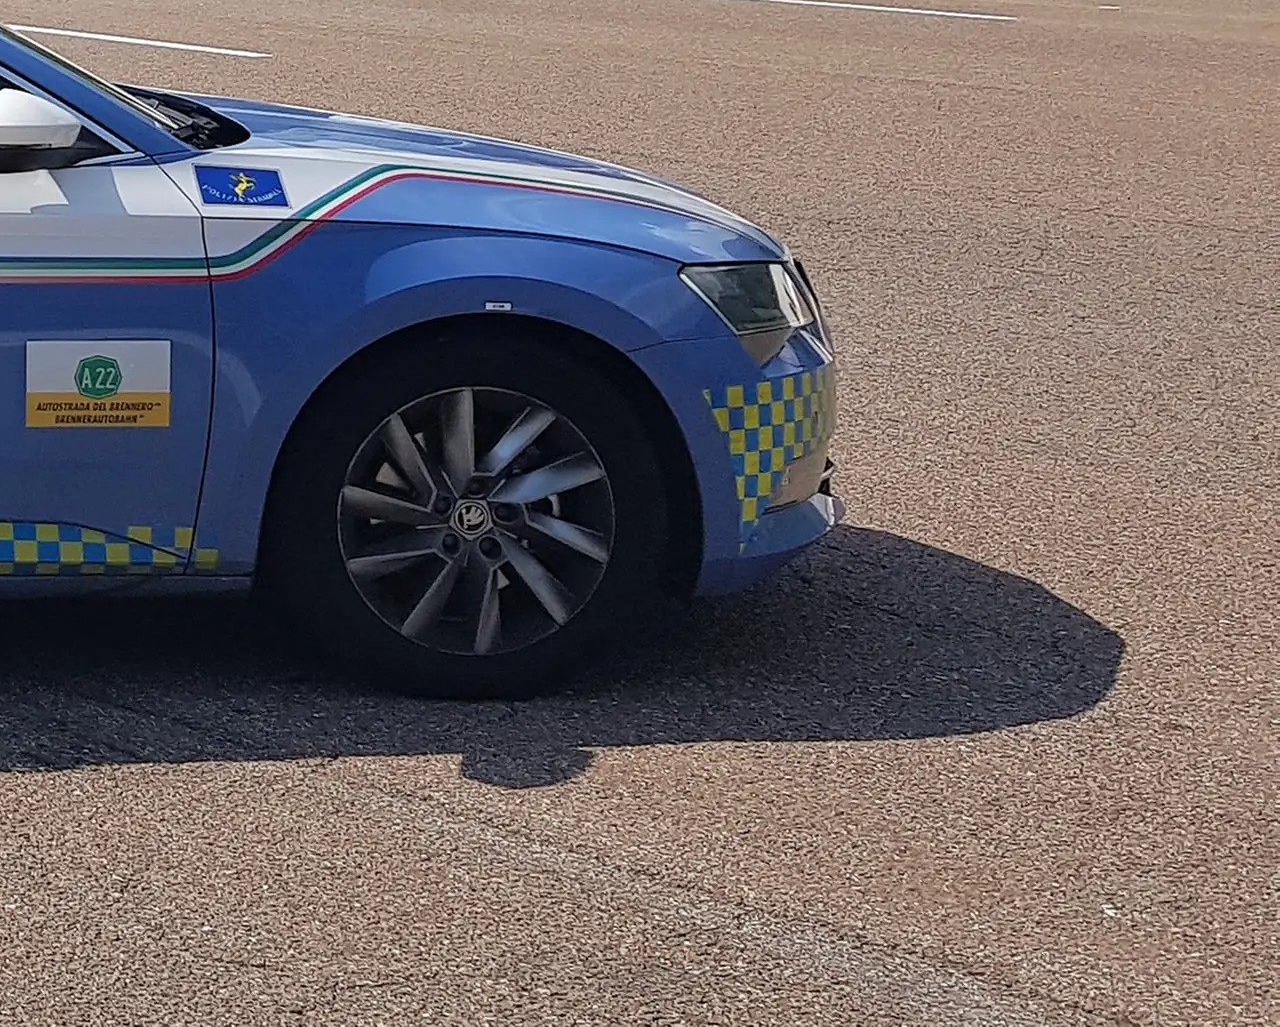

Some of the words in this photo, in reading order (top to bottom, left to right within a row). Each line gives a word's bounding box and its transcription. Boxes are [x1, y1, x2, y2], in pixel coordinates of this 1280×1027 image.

[36, 402, 90, 412] AUTOSTRADA
[92, 402, 107, 412] DEL
[108, 402, 154, 412] BRENNERO
[54, 414, 138, 424] BRENNERAUTOBAHN
